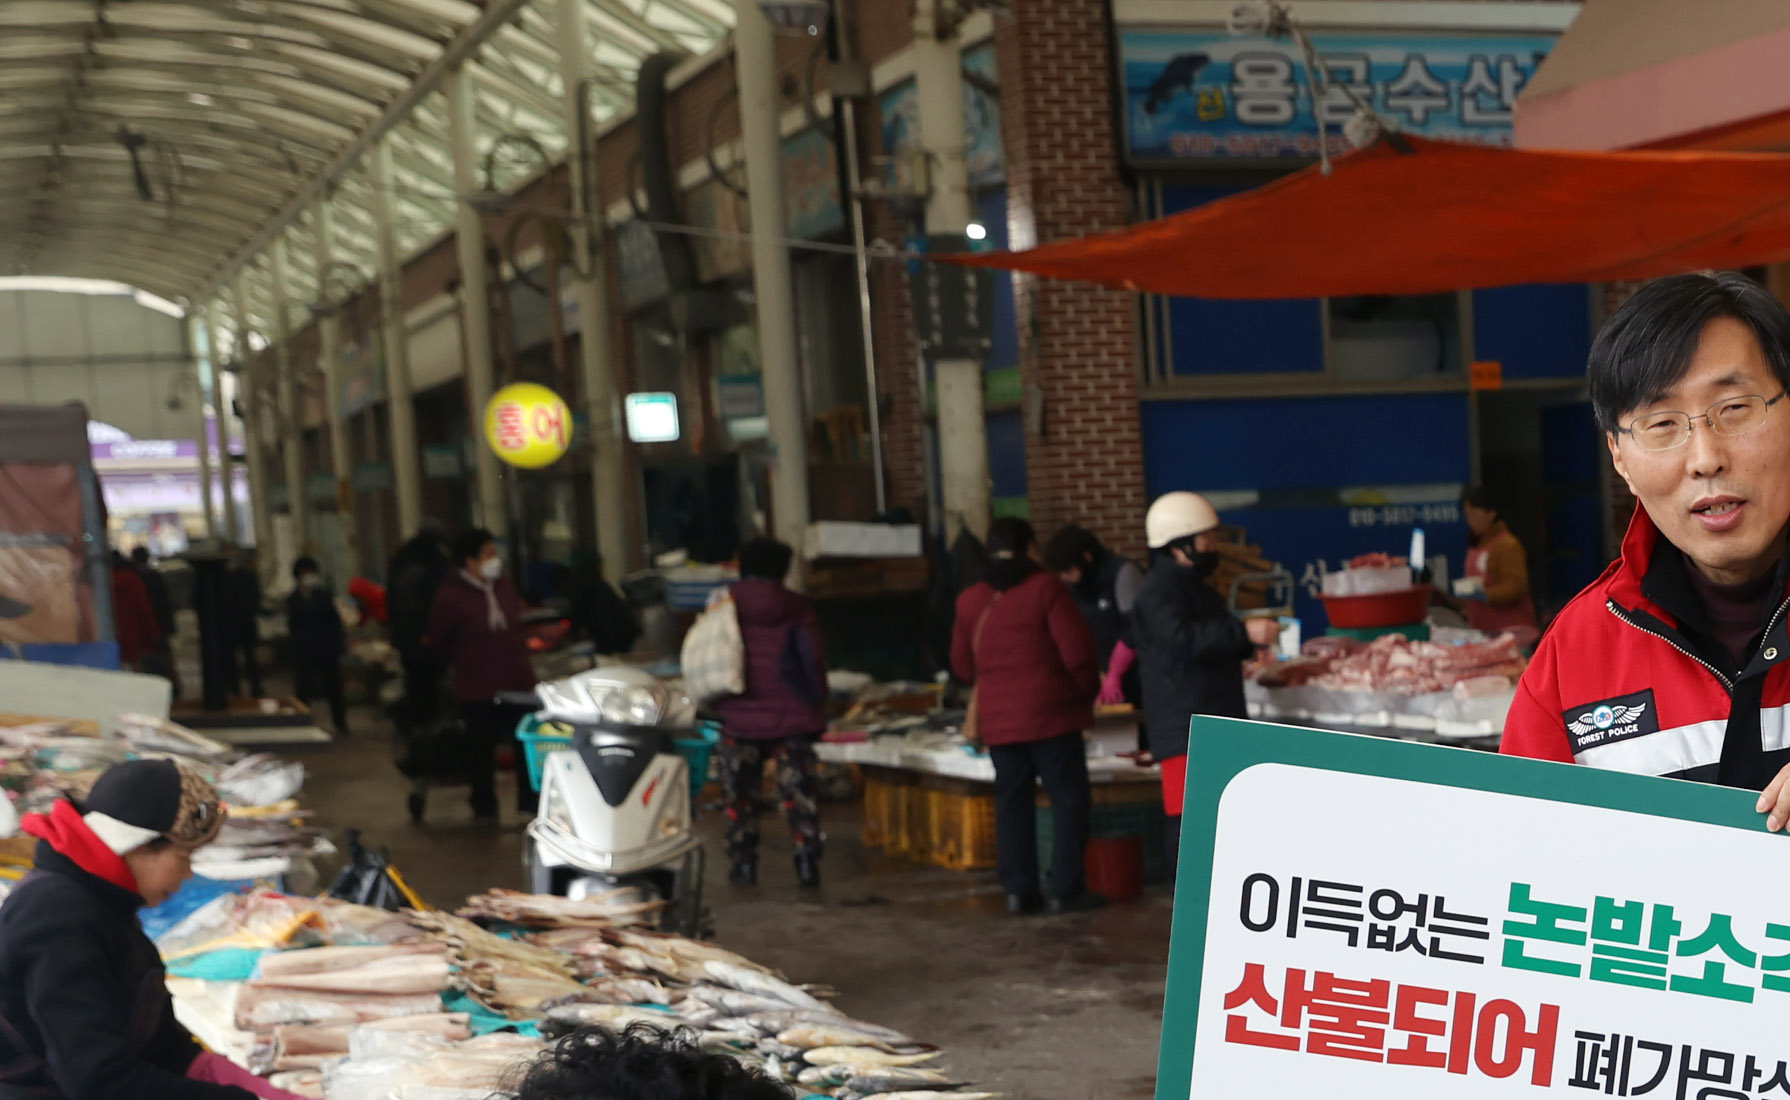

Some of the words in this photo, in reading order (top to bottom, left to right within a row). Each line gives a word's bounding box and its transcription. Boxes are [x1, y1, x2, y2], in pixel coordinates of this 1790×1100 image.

[1577, 732, 1605, 746] FOREST
[1608, 724, 1639, 738] POLICE
[1239, 873, 1489, 964] 이득없는
[1223, 962, 1560, 1087] 산불되어
